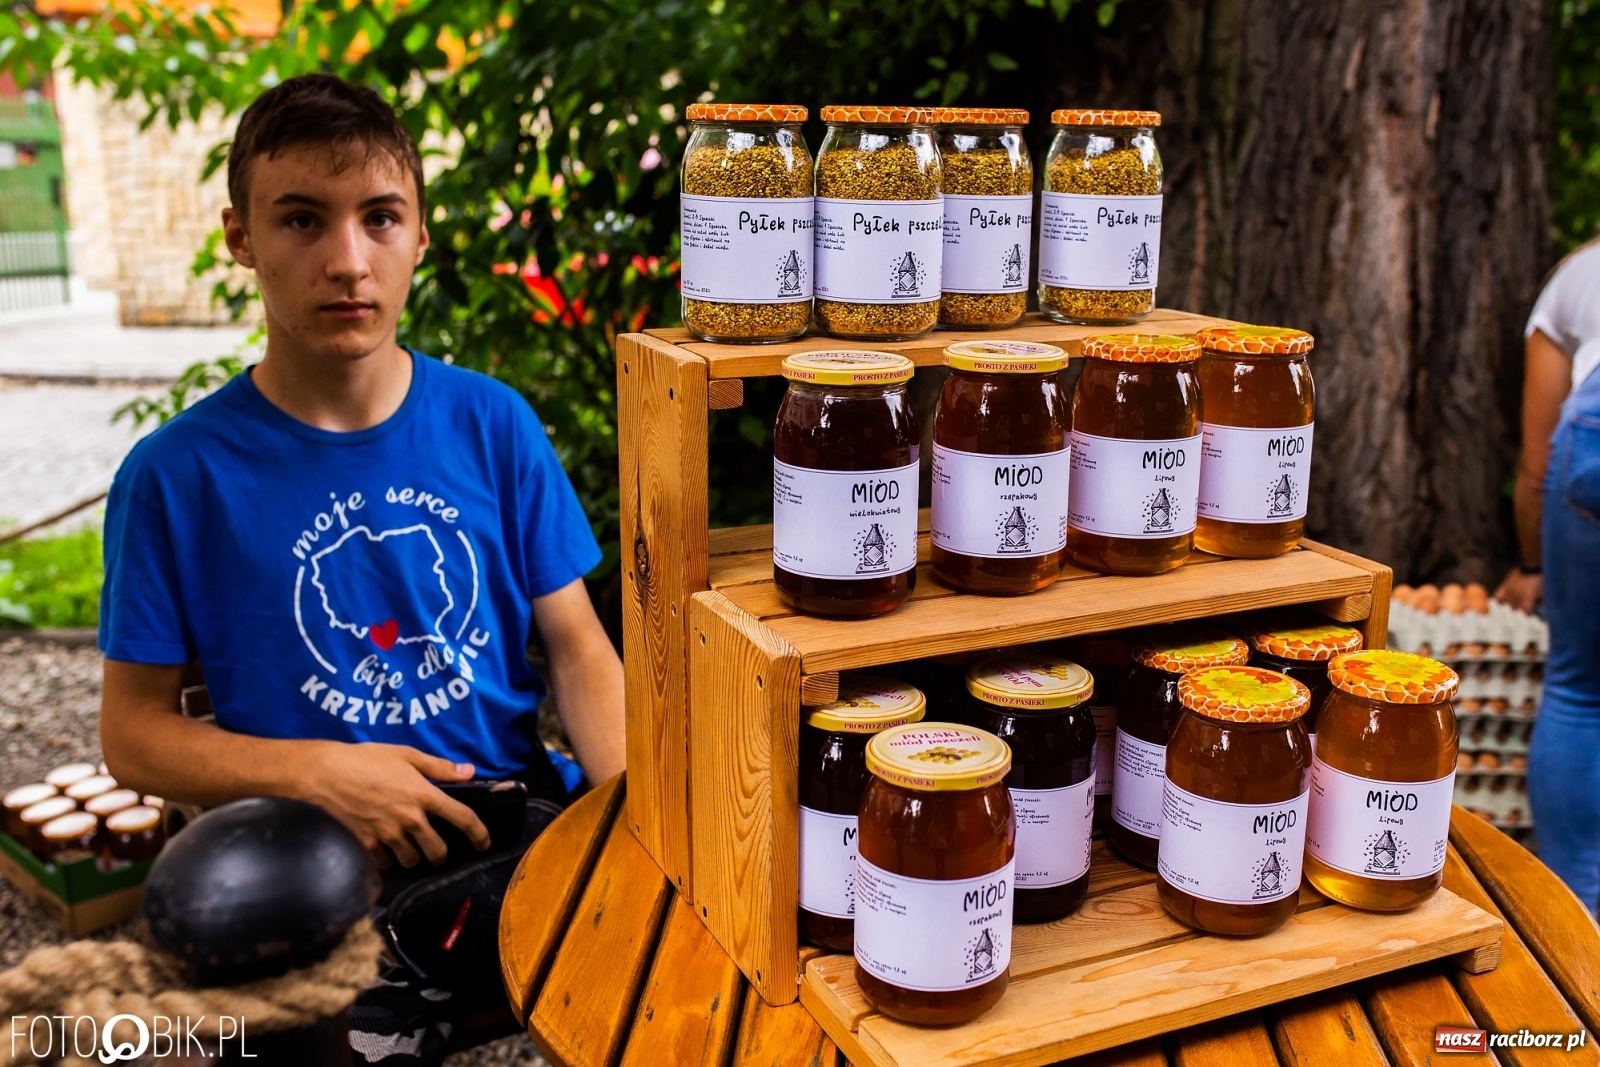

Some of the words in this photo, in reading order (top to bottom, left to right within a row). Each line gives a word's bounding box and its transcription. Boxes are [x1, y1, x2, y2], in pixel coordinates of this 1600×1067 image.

[974, 362, 1001, 370] PROSTO
[1010, 363, 1037, 371] PASIEKI
[1000, 492, 1037, 502] rzepakowy
[850, 507, 901, 517] wielokwiatowy
[292, 491, 366, 560] moje
[385, 486, 460, 524] serce
[353, 653, 405, 699] bije
[417, 642, 456, 681] dla
[982, 691, 1008, 704] PROSTO
[844, 722, 876, 730] PROSTO
[883, 718, 908, 729] PASIEKI
[890, 739, 923, 747] miód
[928, 735, 981, 745] pszczeli
[902, 731, 961, 740] POLSKI
[902, 777, 935, 787] PASIEKI
